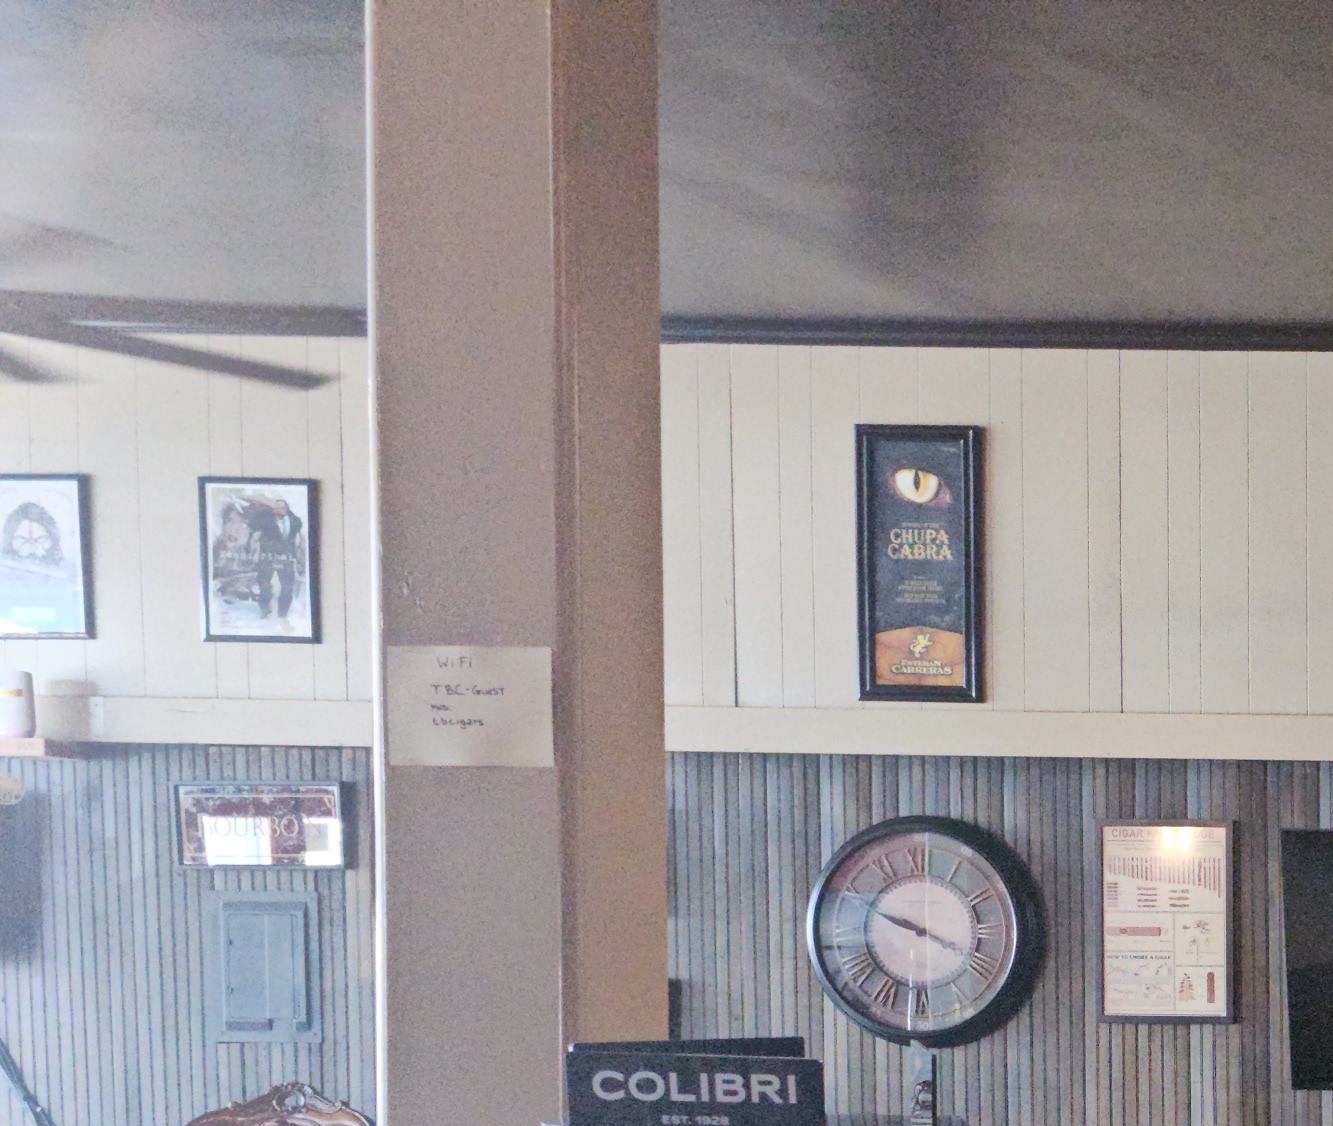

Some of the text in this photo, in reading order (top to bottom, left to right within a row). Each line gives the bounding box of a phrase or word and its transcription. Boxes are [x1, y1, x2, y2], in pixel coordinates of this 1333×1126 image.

[889, 528, 950, 545] CHUPA
[887, 543, 953, 561] CABRA
[891, 664, 953, 676] CARRERAS
[1111, 829, 1143, 838] CIGAR
[591, 1069, 798, 1105] COLIBRI
[661, 1114, 694, 1126] EST.
